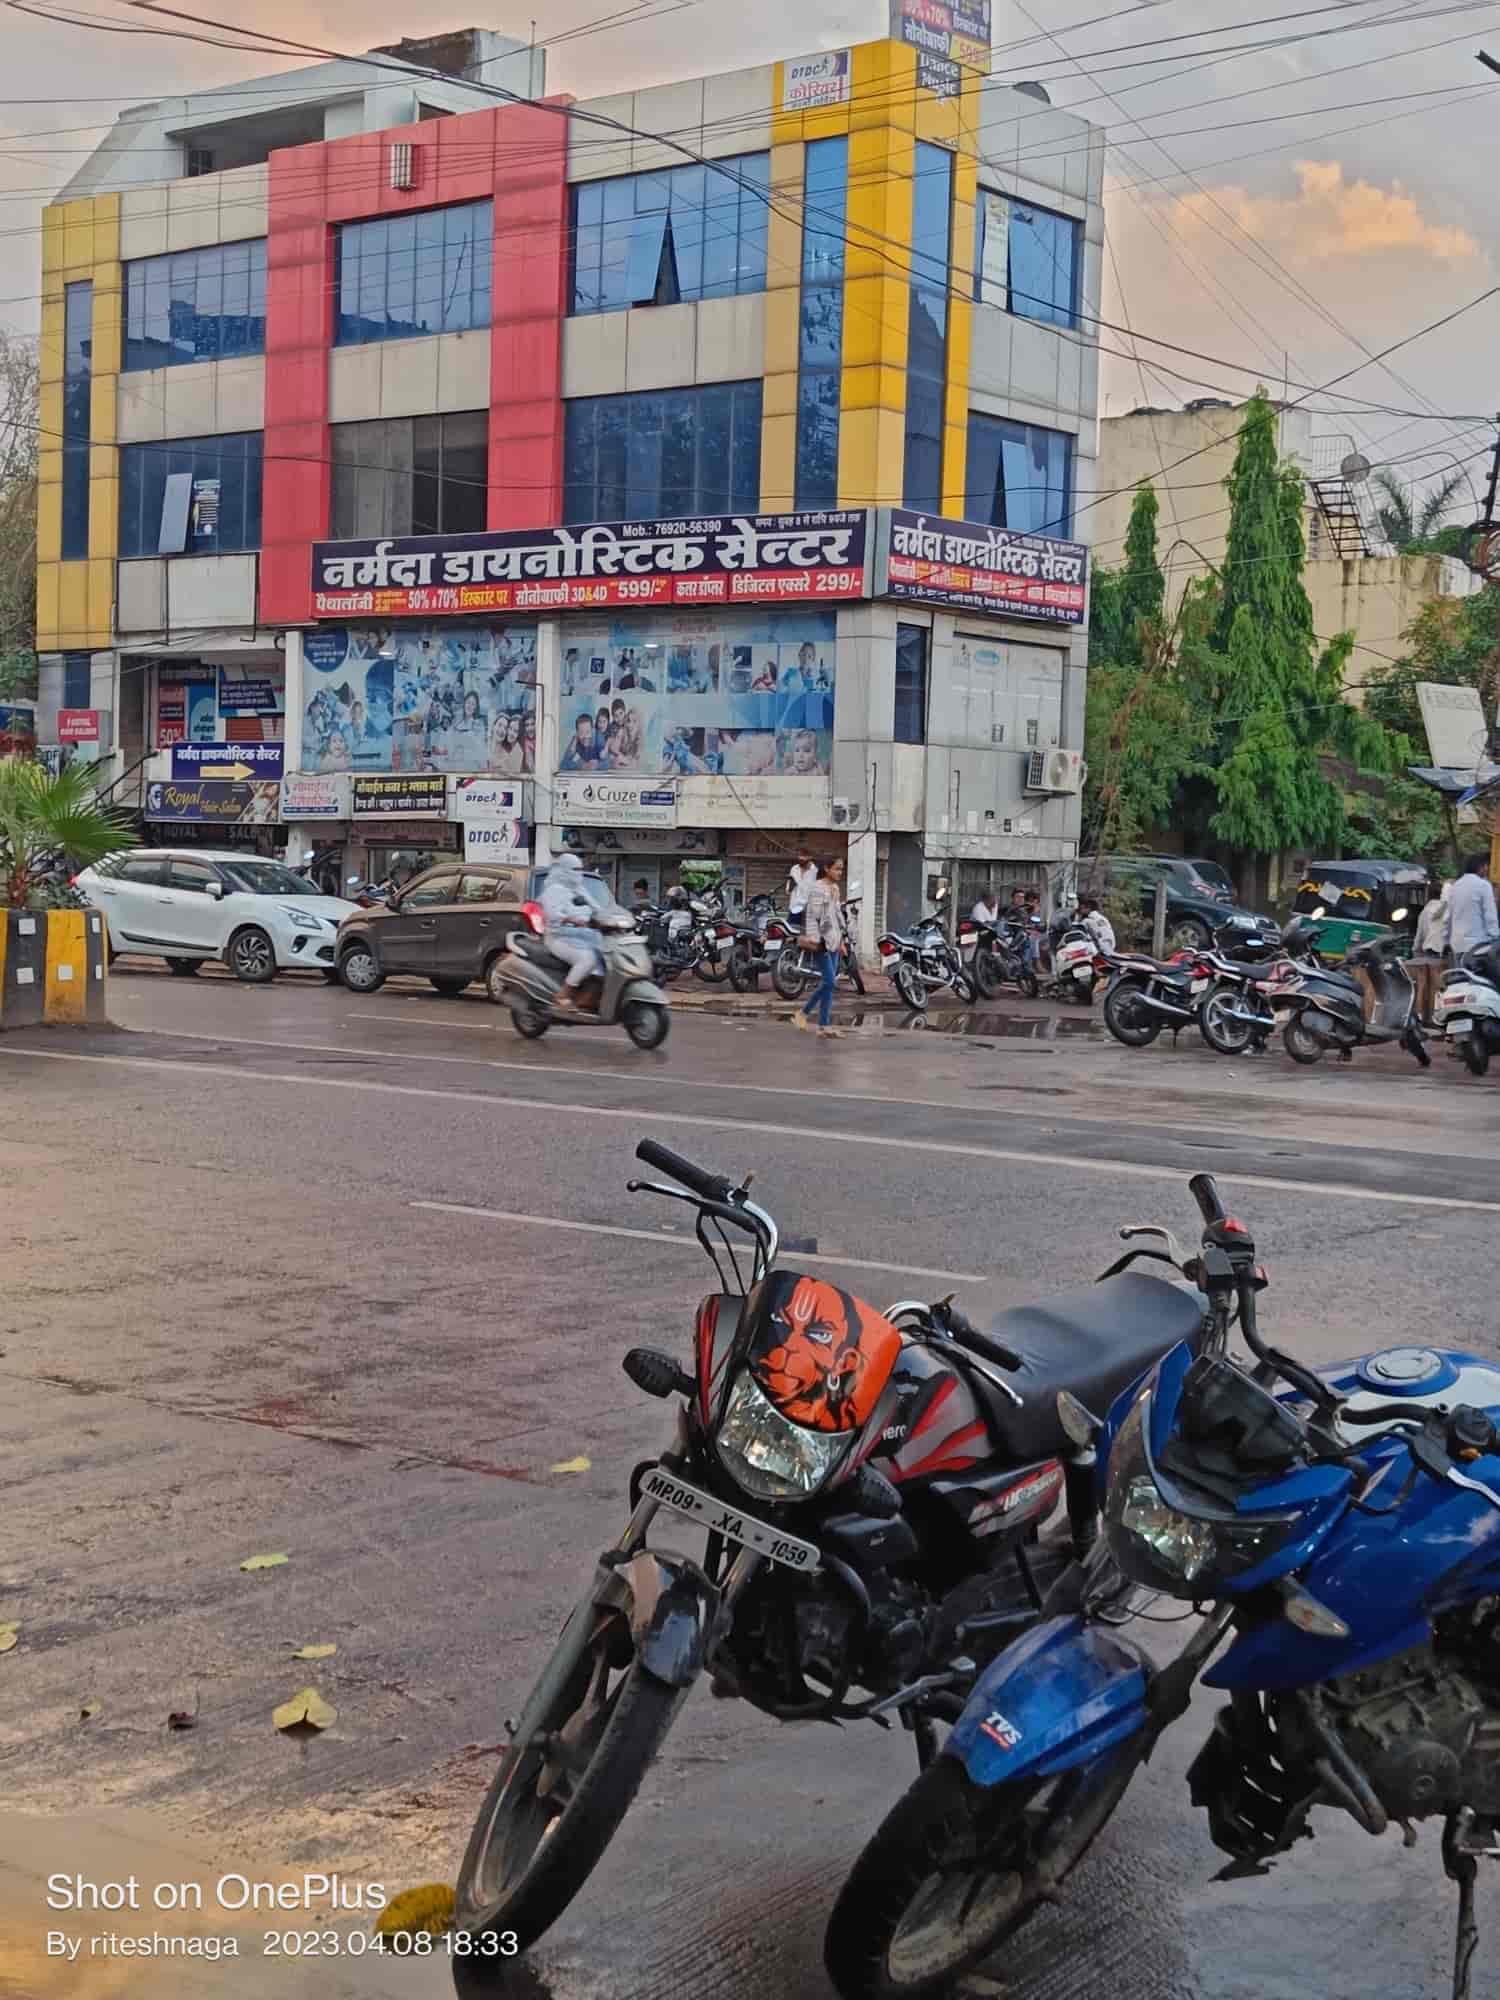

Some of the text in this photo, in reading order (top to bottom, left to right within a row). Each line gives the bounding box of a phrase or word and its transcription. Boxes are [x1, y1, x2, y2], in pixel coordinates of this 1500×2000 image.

[920, 52, 959, 77] Dance
[322, 541, 436, 588] नर्मदा
[714, 518, 853, 569] सेन्टर
[893, 517, 943, 561] नर्मदा
[1040, 541, 1082, 584] सेन्टर
[408, 589, 429, 609] 50%
[437, 587, 459, 608] 70%
[617, 581, 662, 599] 599/-
[815, 573, 861, 592] 299/-
[165, 783, 205, 815] Royal
[465, 793, 490, 802] DTDC
[596, 785, 637, 802] Cruze
[469, 830, 499, 843] DTDC
